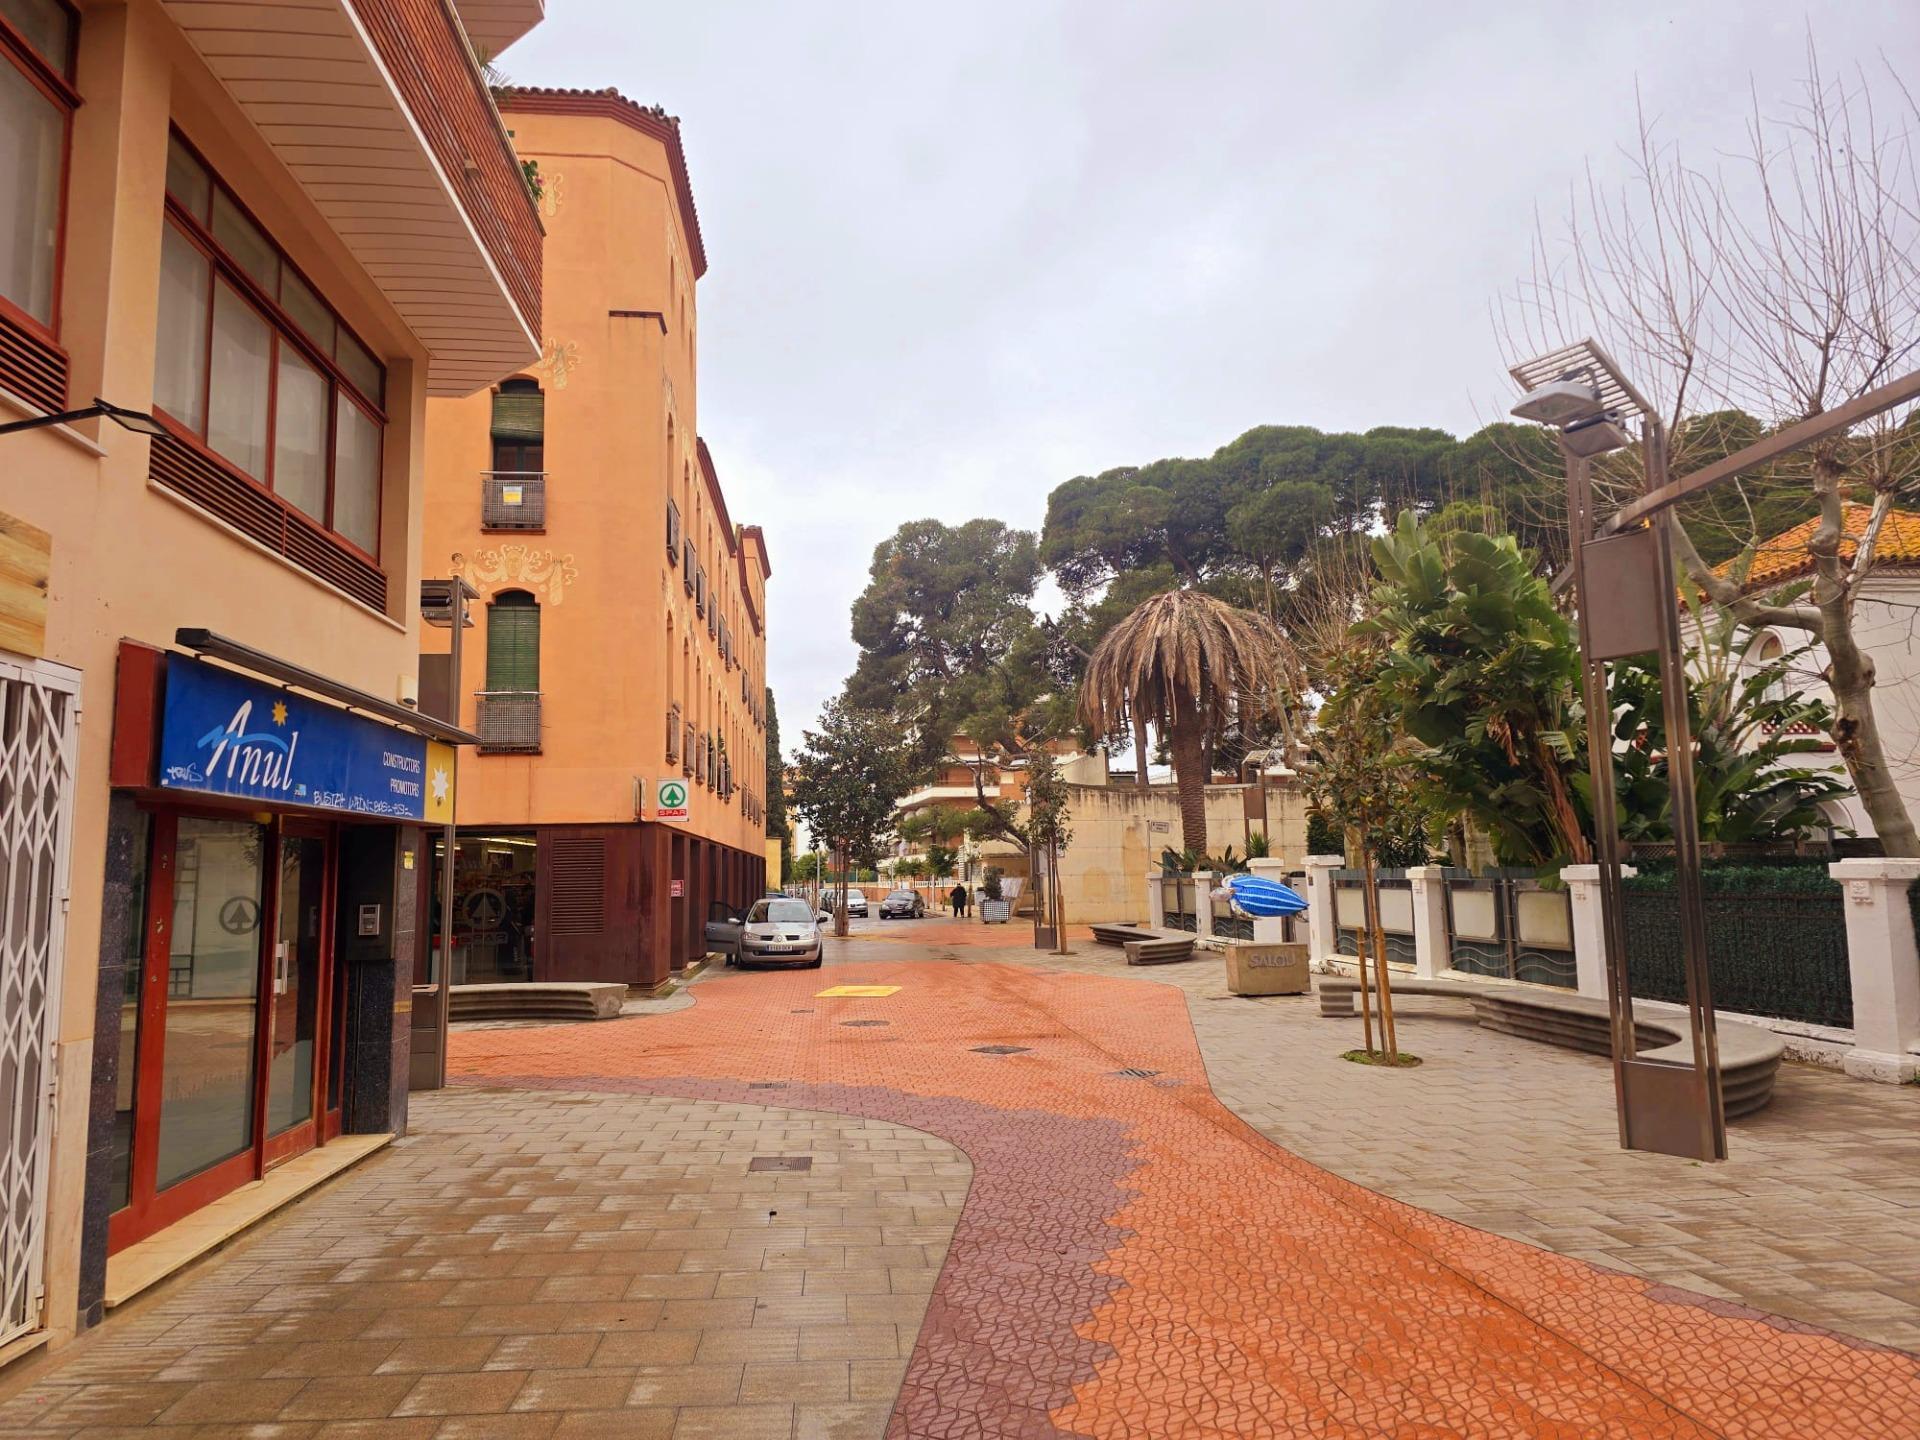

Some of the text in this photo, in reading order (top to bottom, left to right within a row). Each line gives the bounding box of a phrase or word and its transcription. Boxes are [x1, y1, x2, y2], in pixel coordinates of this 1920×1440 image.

[205, 699, 299, 791] Anul
[383, 751, 421, 774] CONSTRUCTORS
[390, 777, 420, 798] PROMOTORS
[1249, 950, 1296, 967] SALOU
